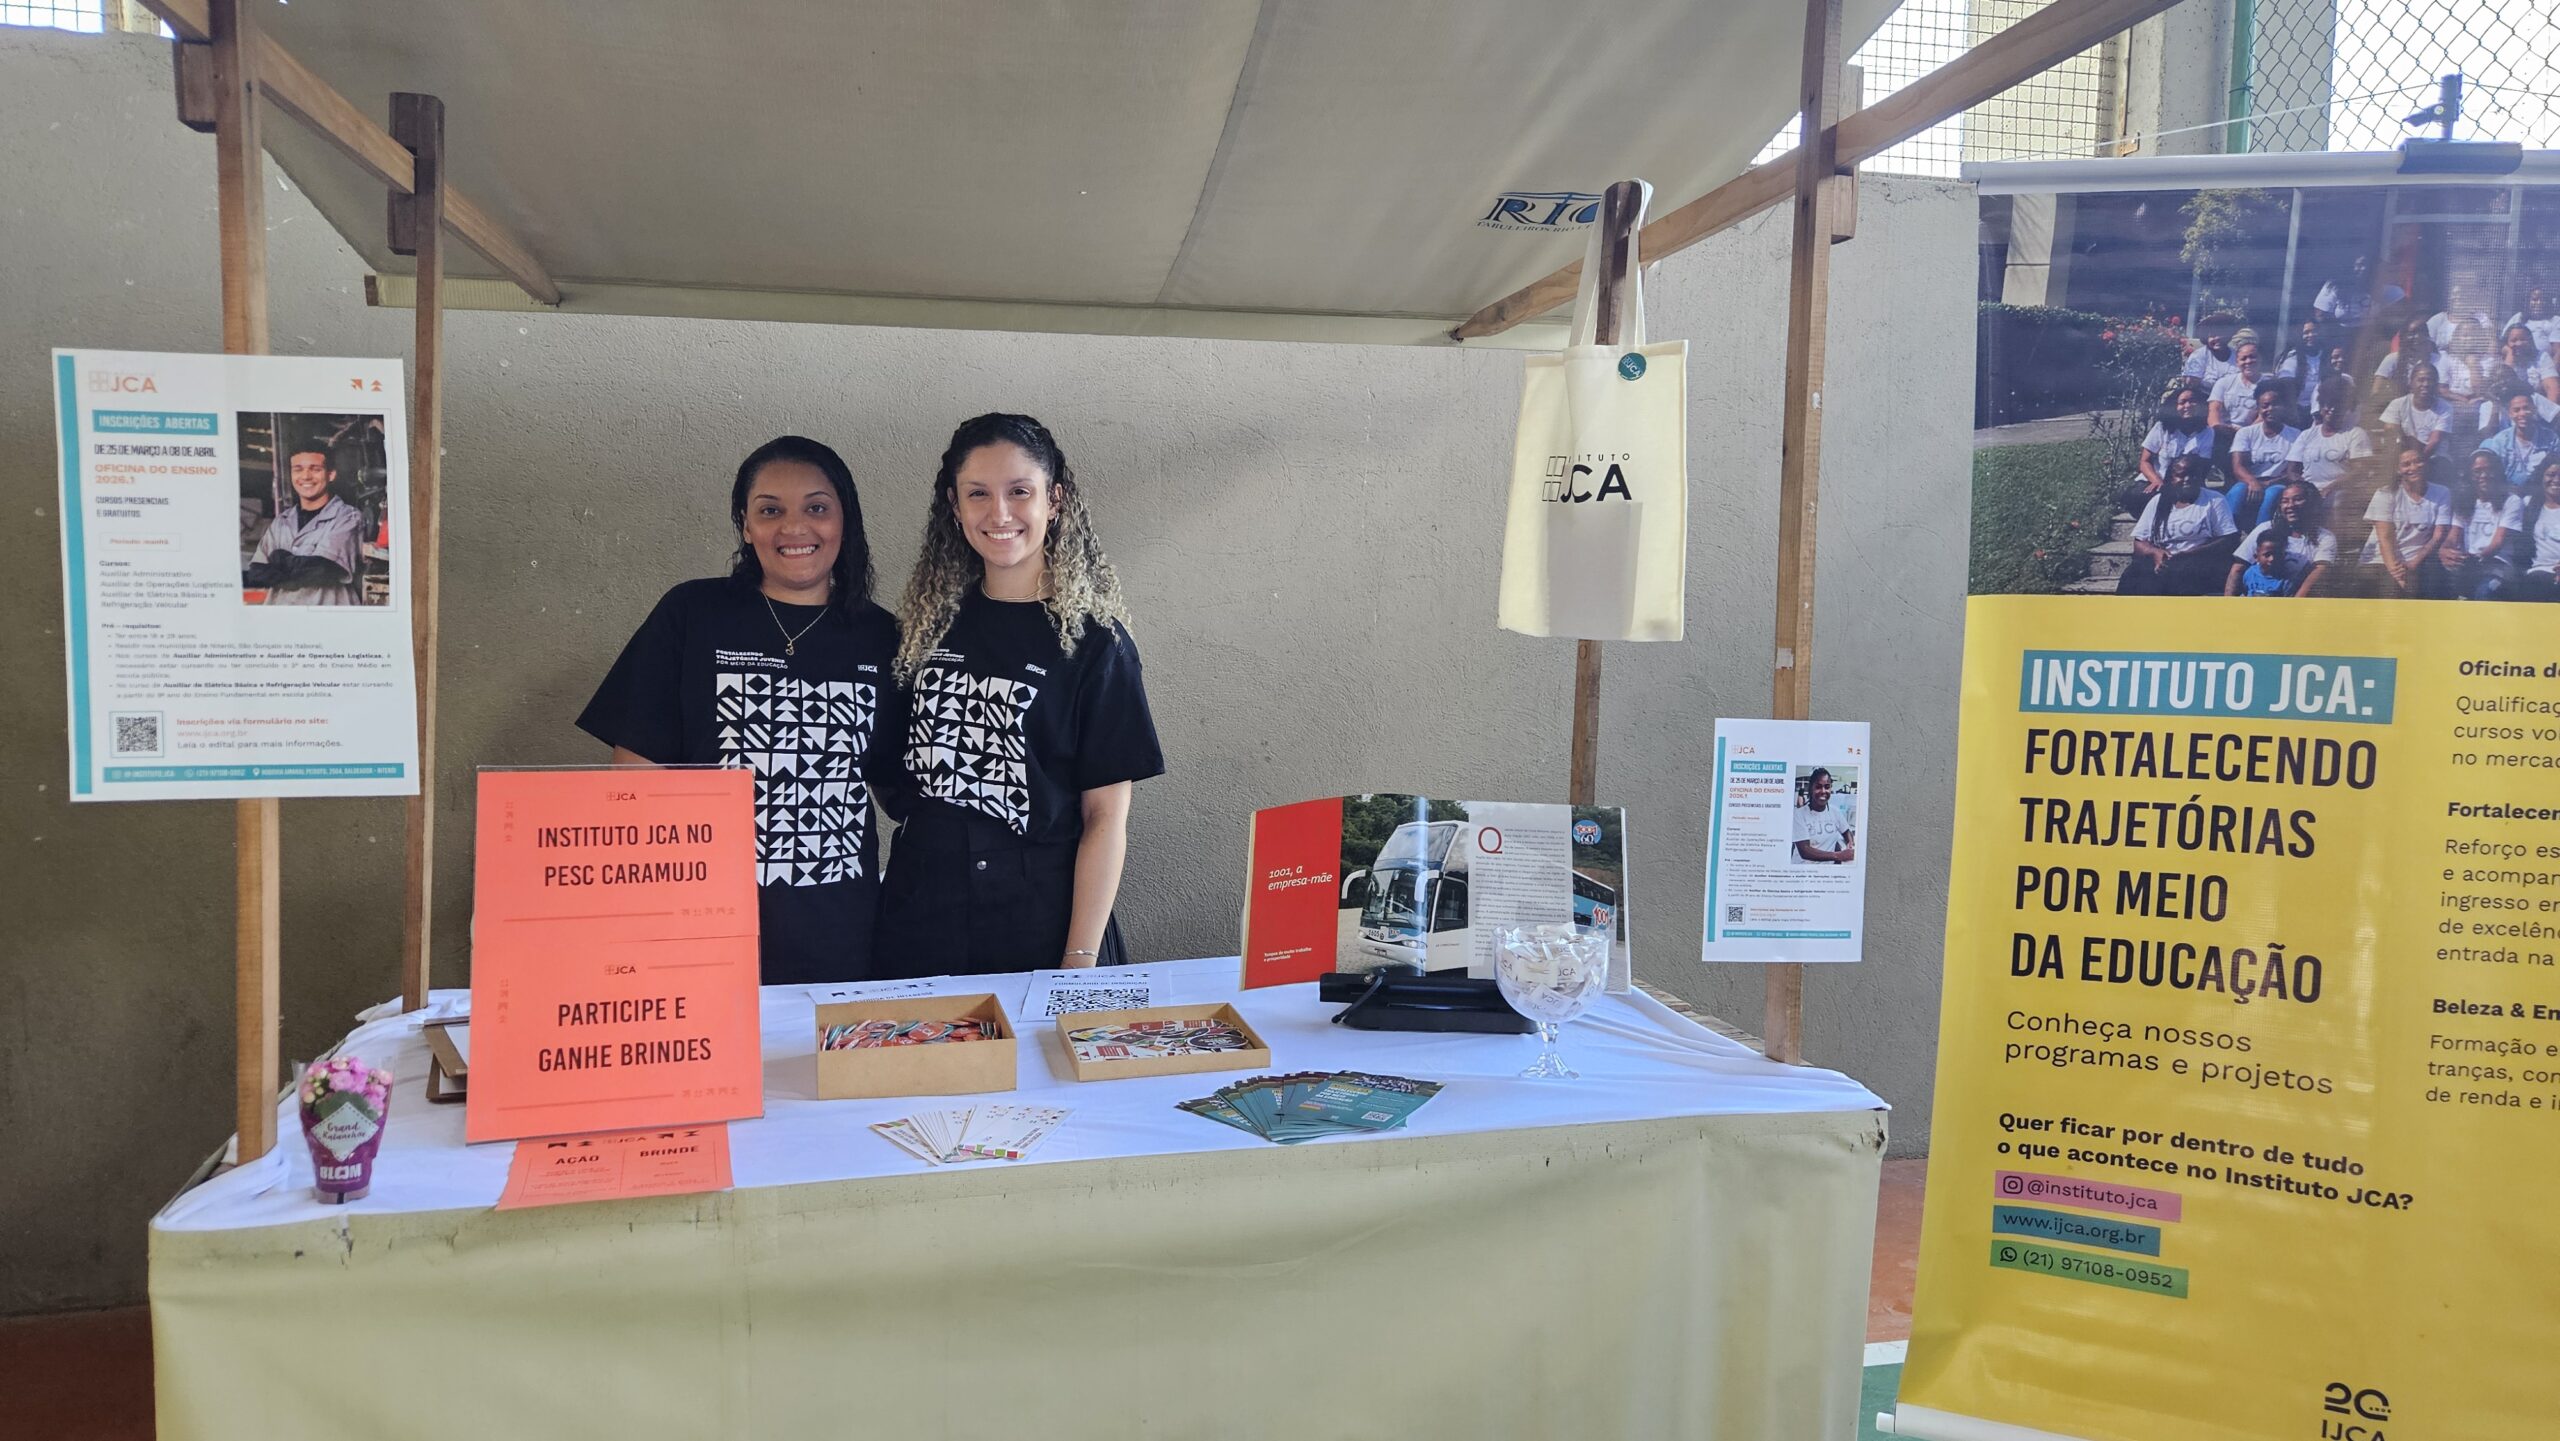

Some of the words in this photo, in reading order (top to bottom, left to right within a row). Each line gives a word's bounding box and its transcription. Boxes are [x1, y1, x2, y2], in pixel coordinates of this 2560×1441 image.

[111, 376, 158, 393] JCA
[99, 414, 160, 430] INSCRIÇÕES
[164, 416, 210, 430] ABERTAS
[94, 443, 106, 455] DE
[107, 444, 117, 455] 25
[118, 444, 129, 455] DE
[130, 444, 160, 458] MARÇO
[181, 446, 193, 457] DE
[193, 446, 217, 458] ABRIL
[95, 463, 146, 474] OFICINA
[149, 464, 168, 475] DO
[171, 465, 217, 476] ENSINO
[95, 475, 135, 485] 2026.1
[96, 496, 123, 505] CURSOS
[124, 496, 169, 506] PRESENCIAIS
[100, 570, 130, 578] Auxiliar
[132, 570, 192, 578] Administrativo
[100, 580, 131, 588] Auxiliar
[145, 581, 190, 590] Operações
[101, 591, 131, 599] Auxiliar
[133, 591, 144, 599] de
[146, 591, 178, 599] Elétrica
[101, 601, 153, 610] Refrigeração
[2459, 660, 2536, 678] Oficina
[2543, 662, 2560, 678] d
[2029, 657, 2253, 712] INSTITUTO
[2268, 662, 2377, 716] JCA:
[176, 717, 224, 726] Inscrições
[227, 717, 240, 725] via
[243, 717, 292, 725] formulário
[308, 716, 329, 725] site:
[2454, 726, 2524, 740] cursos
[177, 741, 197, 749] Leia
[208, 740, 235, 749] edital
[237, 741, 258, 750] para
[261, 740, 283, 748] mais
[285, 740, 344, 749] informações.
[2024, 728, 2378, 790] FORTALECENDO
[2452, 753, 2478, 766] no
[615, 792, 637, 801] JCA
[538, 825, 638, 848] INSTITUTO
[645, 824, 680, 845] JCA
[687, 823, 713, 844] NO
[2019, 794, 2317, 859] TRAJETÓRIAS
[2446, 839, 2527, 860] Reforço
[544, 865, 594, 887] PESC
[602, 861, 707, 885] CARAMUJO
[1269, 867, 1293, 878] 1001,
[1296, 865, 1303, 874] a
[2443, 868, 2455, 881] e
[1268, 872, 1333, 891] empresa-mãe
[2015, 865, 2100, 914] POR
[2115, 870, 2228, 923] MEIO
[2441, 891, 2529, 912] ingresso
[2438, 918, 2464, 934] de
[2472, 921, 2560, 940] excelên
[2436, 947, 2519, 964] entrada
[2528, 952, 2555, 967] na
[614, 966, 637, 975] JCA
[2010, 932, 2065, 981] DA
[2080, 936, 2323, 1004] EDUCAÇÃO
[558, 998, 667, 1027] PARTICIPE
[675, 997, 686, 1019] E
[2433, 999, 2504, 1017] Beleza
[2510, 1003, 2525, 1018] &
[2006, 1009, 2134, 1043] Conheça
[2144, 1022, 2252, 1053] nossos
[538, 1045, 612, 1072] GANHE
[620, 1038, 712, 1066] BRINDES
[2430, 1034, 2537, 1057] Formação
[2546, 1045, 2558, 1057] e
[2004, 1040, 2159, 1074] programas
[2171, 1056, 2189, 1076] e
[2200, 1059, 2334, 1096] projetos
[2427, 1061, 2514, 1082] tranças,
[2425, 1086, 2451, 1103] de
[2460, 1090, 2521, 1108] renda
[2529, 1097, 2542, 1109] e
[327, 1122, 358, 1132] Grand
[639, 1145, 700, 1158] BRINDE
[1998, 1111, 2055, 1133] Quer
[2060, 1116, 2116, 1139] ficar
[2122, 1126, 2164, 1146] por
[2170, 1130, 2256, 1160] dentro
[2262, 1145, 2295, 1166] de
[2302, 1150, 2365, 1177] tudo
[1997, 1141, 2011, 1156] o
[2017, 1142, 2060, 1161] que
[2067, 1147, 2179, 1176] acontece
[2186, 1162, 2218, 1181] no
[2225, 1166, 2339, 1202] Instituto
[2346, 1188, 2415, 1212] JCA?
[2027, 1179, 2158, 1211] @instituto.jca
[2003, 1213, 2146, 1244] www.ijca.org.br
[2023, 1249, 2054, 1271] (21)
[2061, 1257, 2174, 1289] 97108-0952
